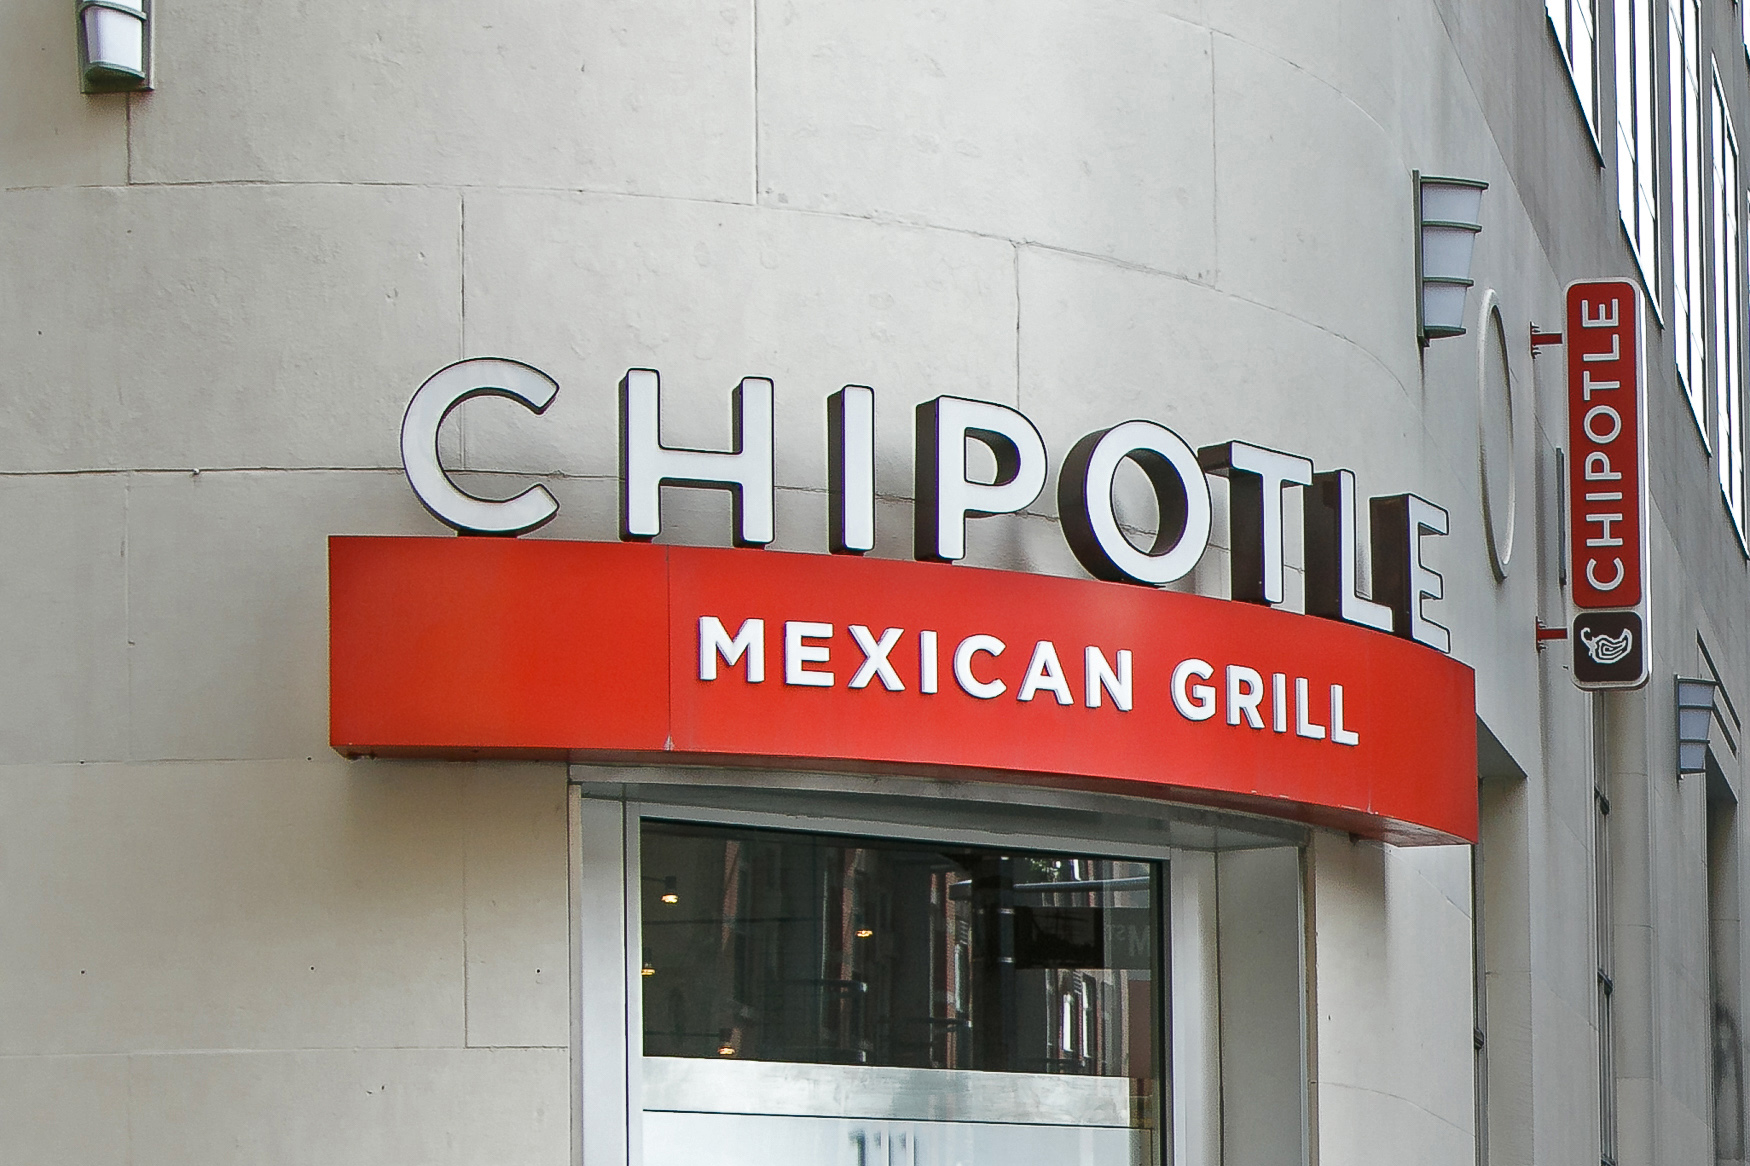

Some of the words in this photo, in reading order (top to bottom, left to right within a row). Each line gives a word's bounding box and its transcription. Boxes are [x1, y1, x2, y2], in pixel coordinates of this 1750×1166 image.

[400, 356, 1451, 654] CHIPOTLE
[1581, 298, 1625, 591] CHIPOTLE
[698, 615, 1133, 712] MEXICAN
[1170, 656, 1360, 746] GRILL
